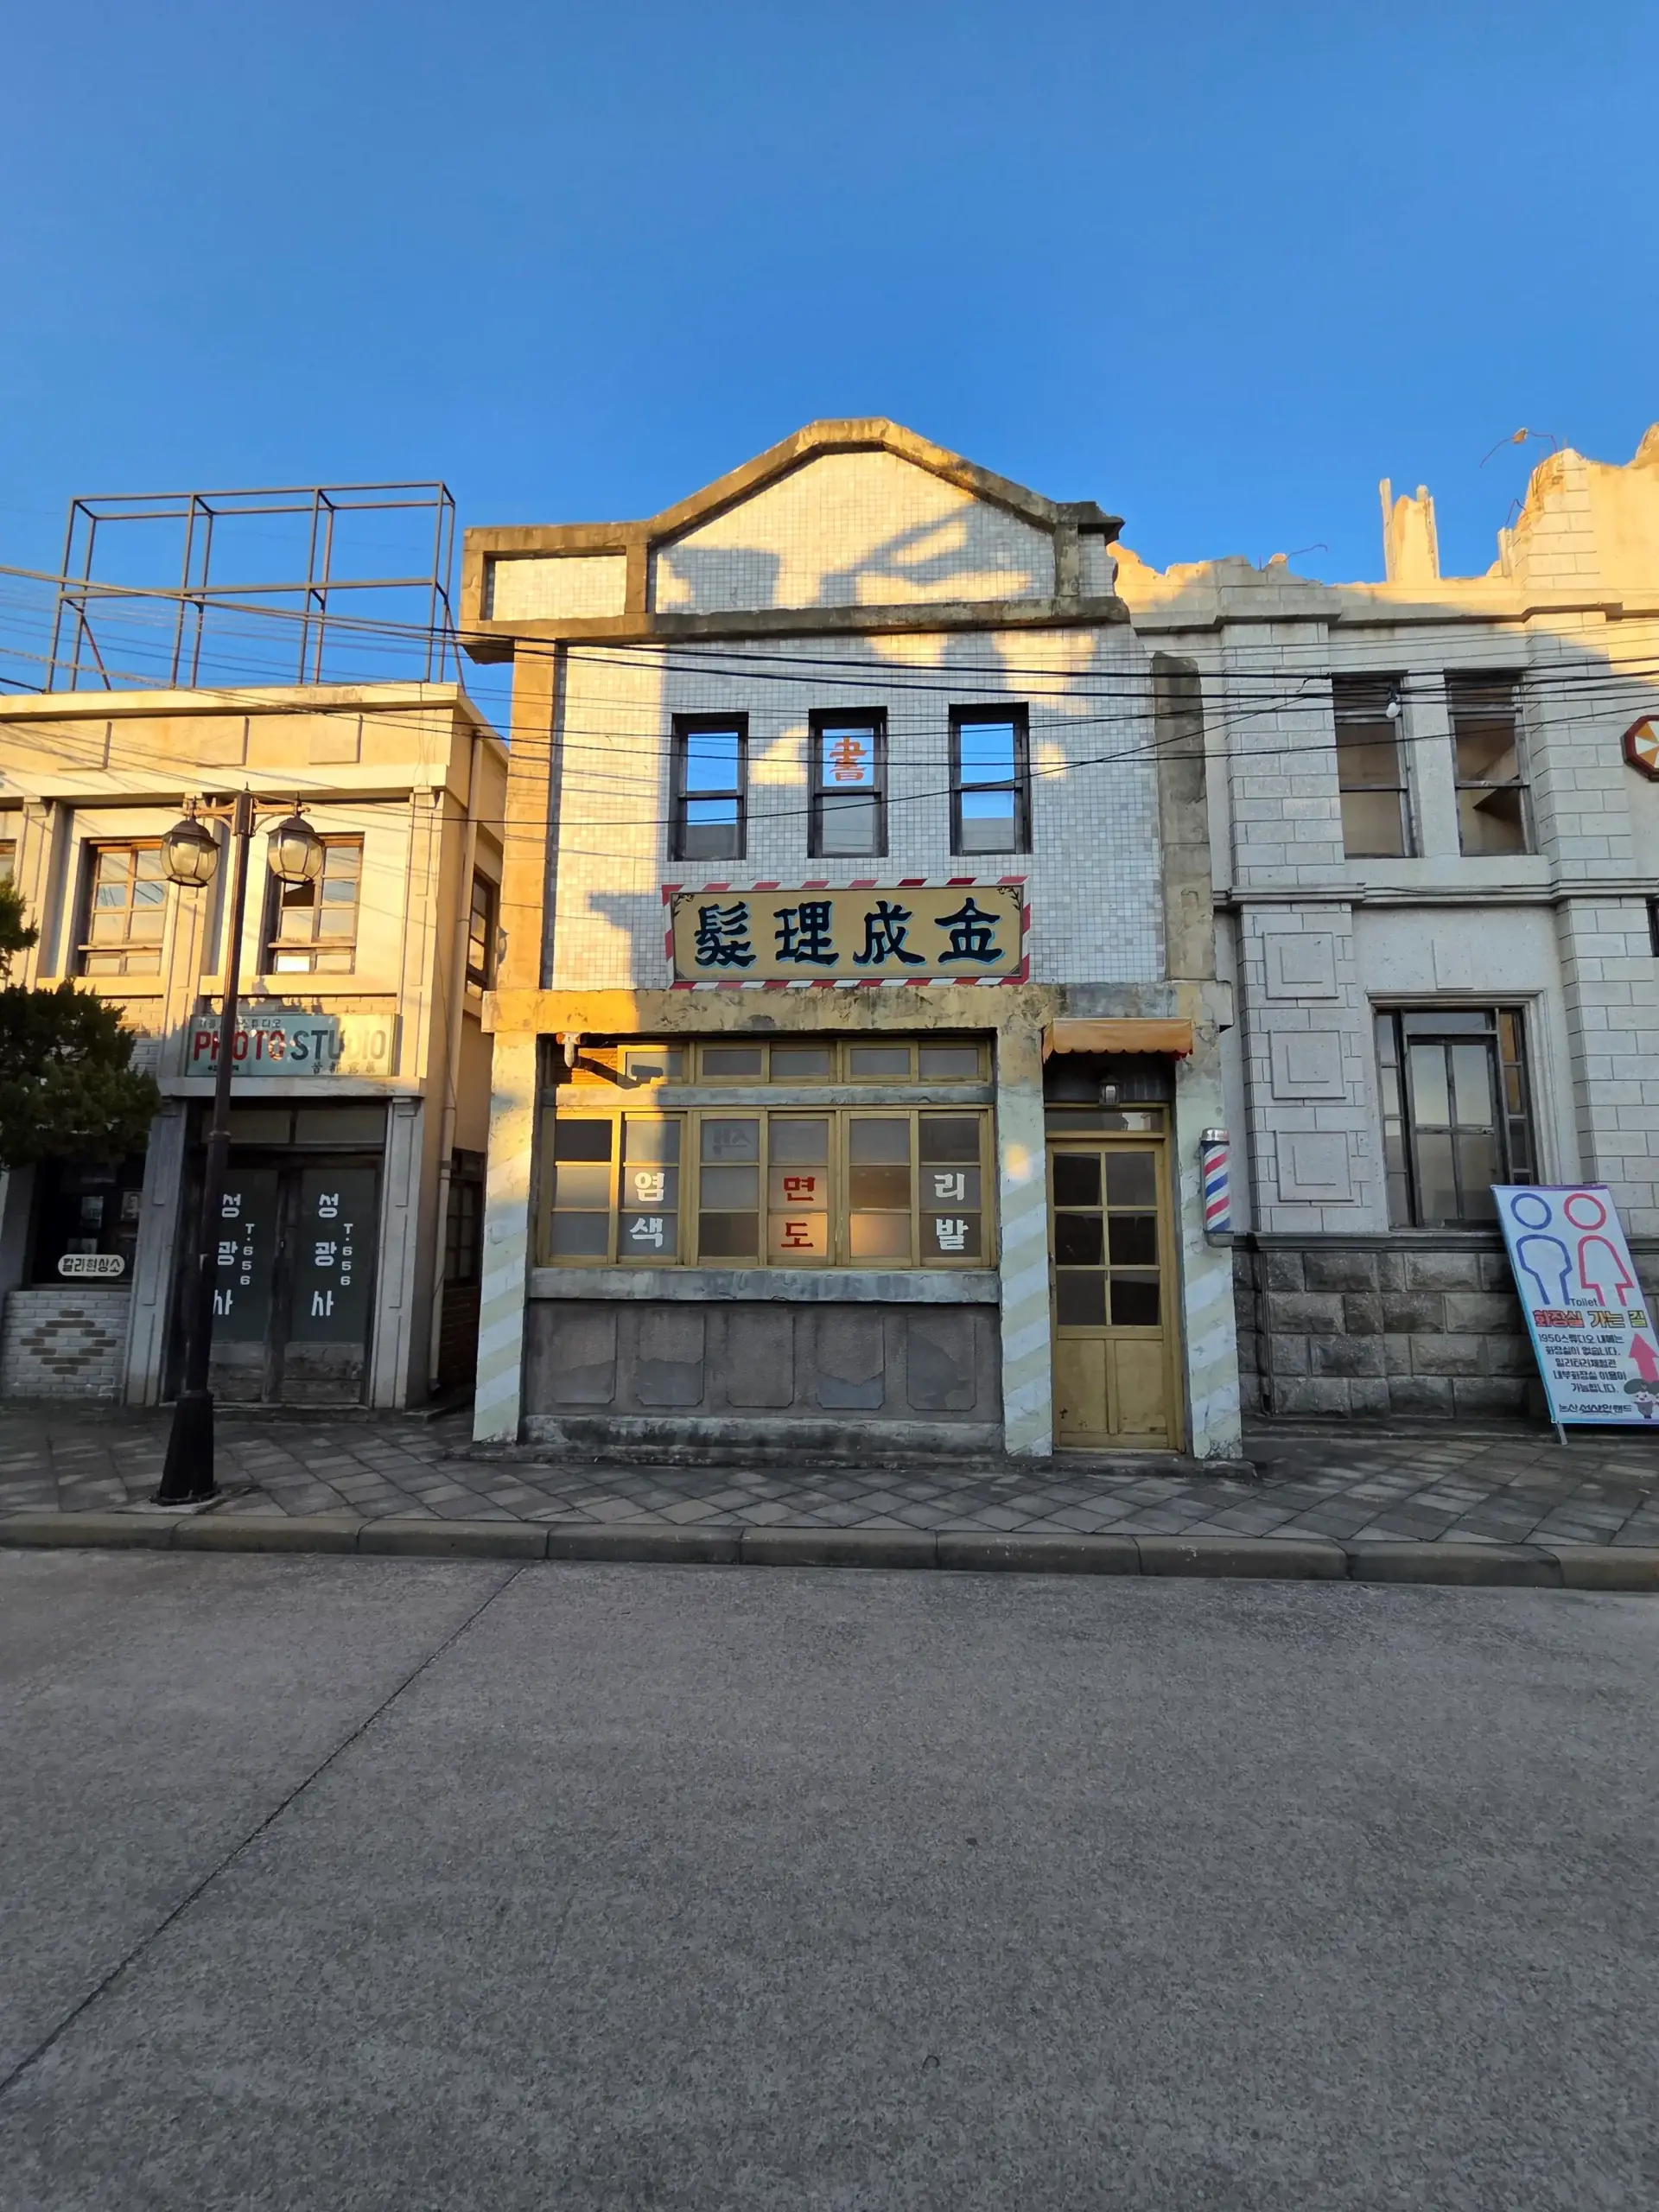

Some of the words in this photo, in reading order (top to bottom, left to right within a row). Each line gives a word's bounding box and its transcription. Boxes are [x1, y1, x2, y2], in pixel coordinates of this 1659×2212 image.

[289, 1029, 386, 1061] STUDIO
[629, 1170, 665, 1248] 염색
[780, 1176, 816, 1249] 면도
[311, 1193, 340, 1316] 성광사
[1569, 1298, 1599, 1307] Toilet
[1532, 1309, 1586, 1328] 화장실
[1586, 1310, 1626, 1328] 가는
[1627, 1310, 1648, 1328] 길
[1538, 1333, 1596, 1344] 1950스튜디오
[1545, 1345, 1580, 1356] 화장실이
[1582, 1345, 1621, 1357] 없습니다.
[1553, 1370, 1598, 1380] 내부화장실
[1599, 1370, 1627, 1381] 이용이
